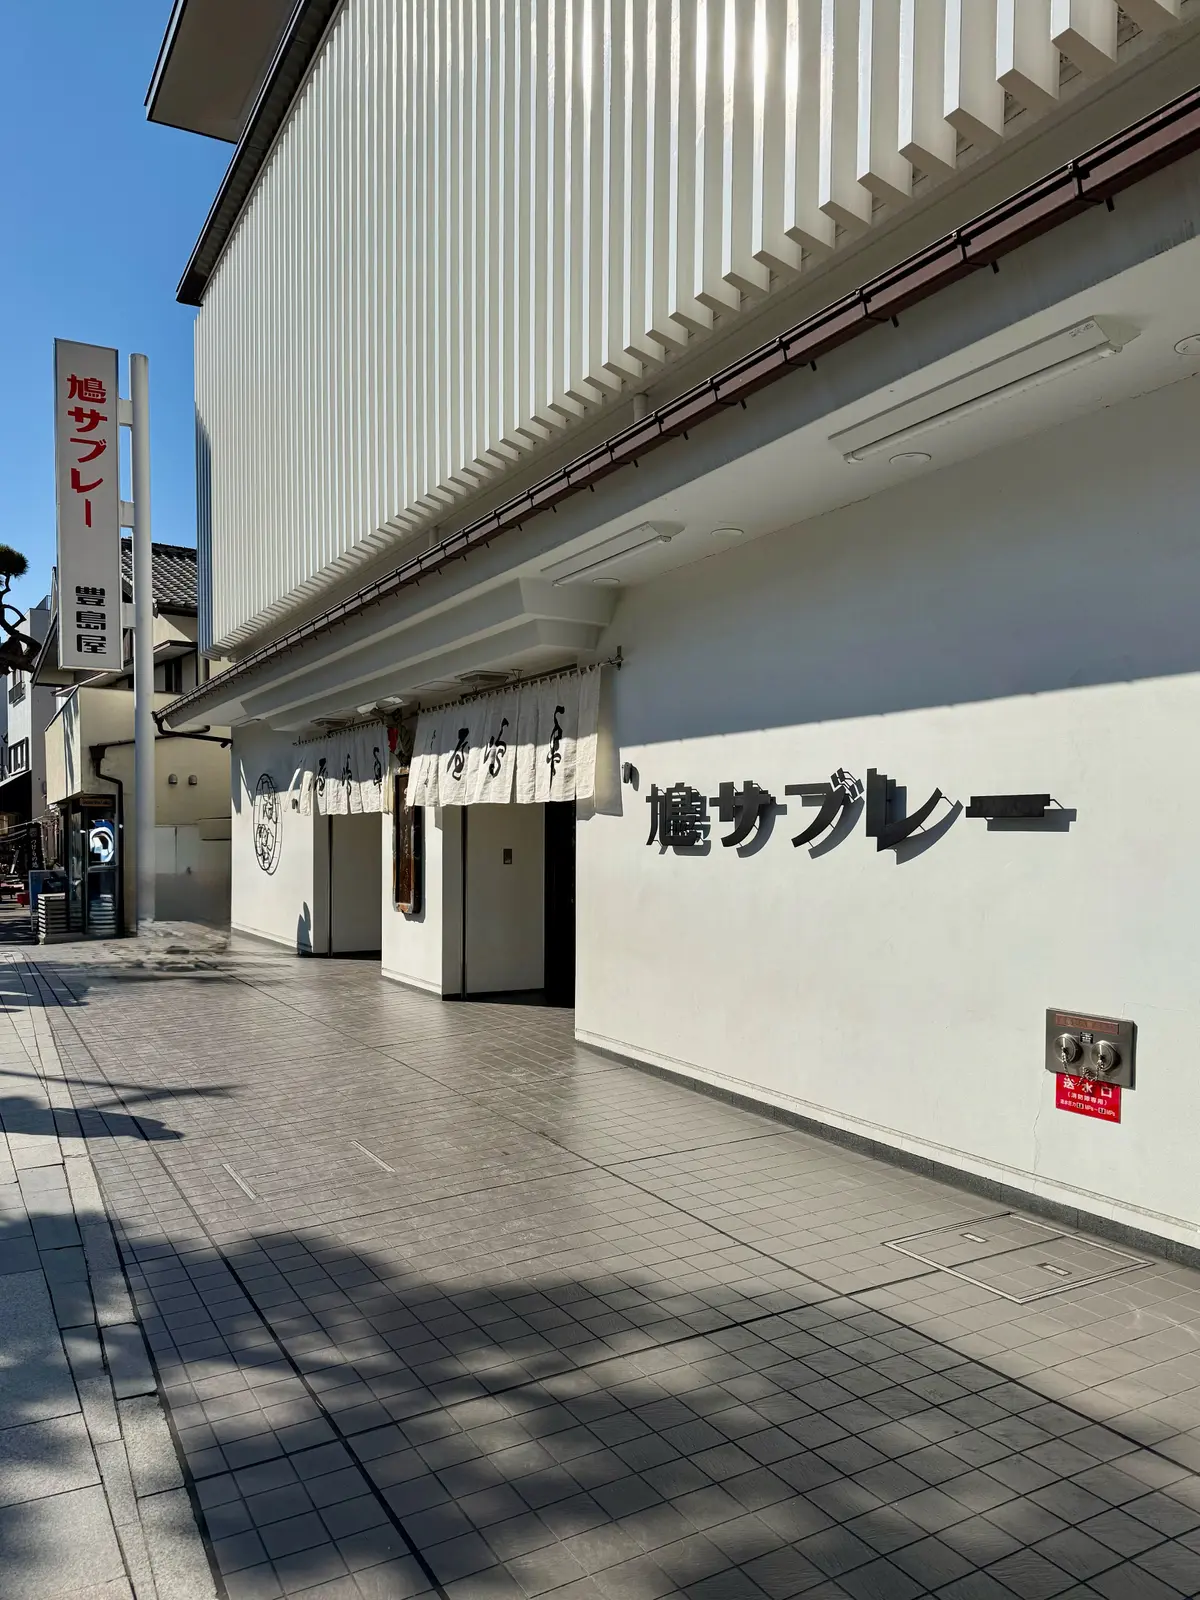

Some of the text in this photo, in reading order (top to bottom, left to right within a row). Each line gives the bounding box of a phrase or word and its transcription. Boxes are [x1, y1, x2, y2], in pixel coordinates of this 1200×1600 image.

[67, 374, 108, 528] 鳩サブレー
[75, 585, 107, 655] 豊島屋
[645, 767, 1052, 853] 鳩サブレー
